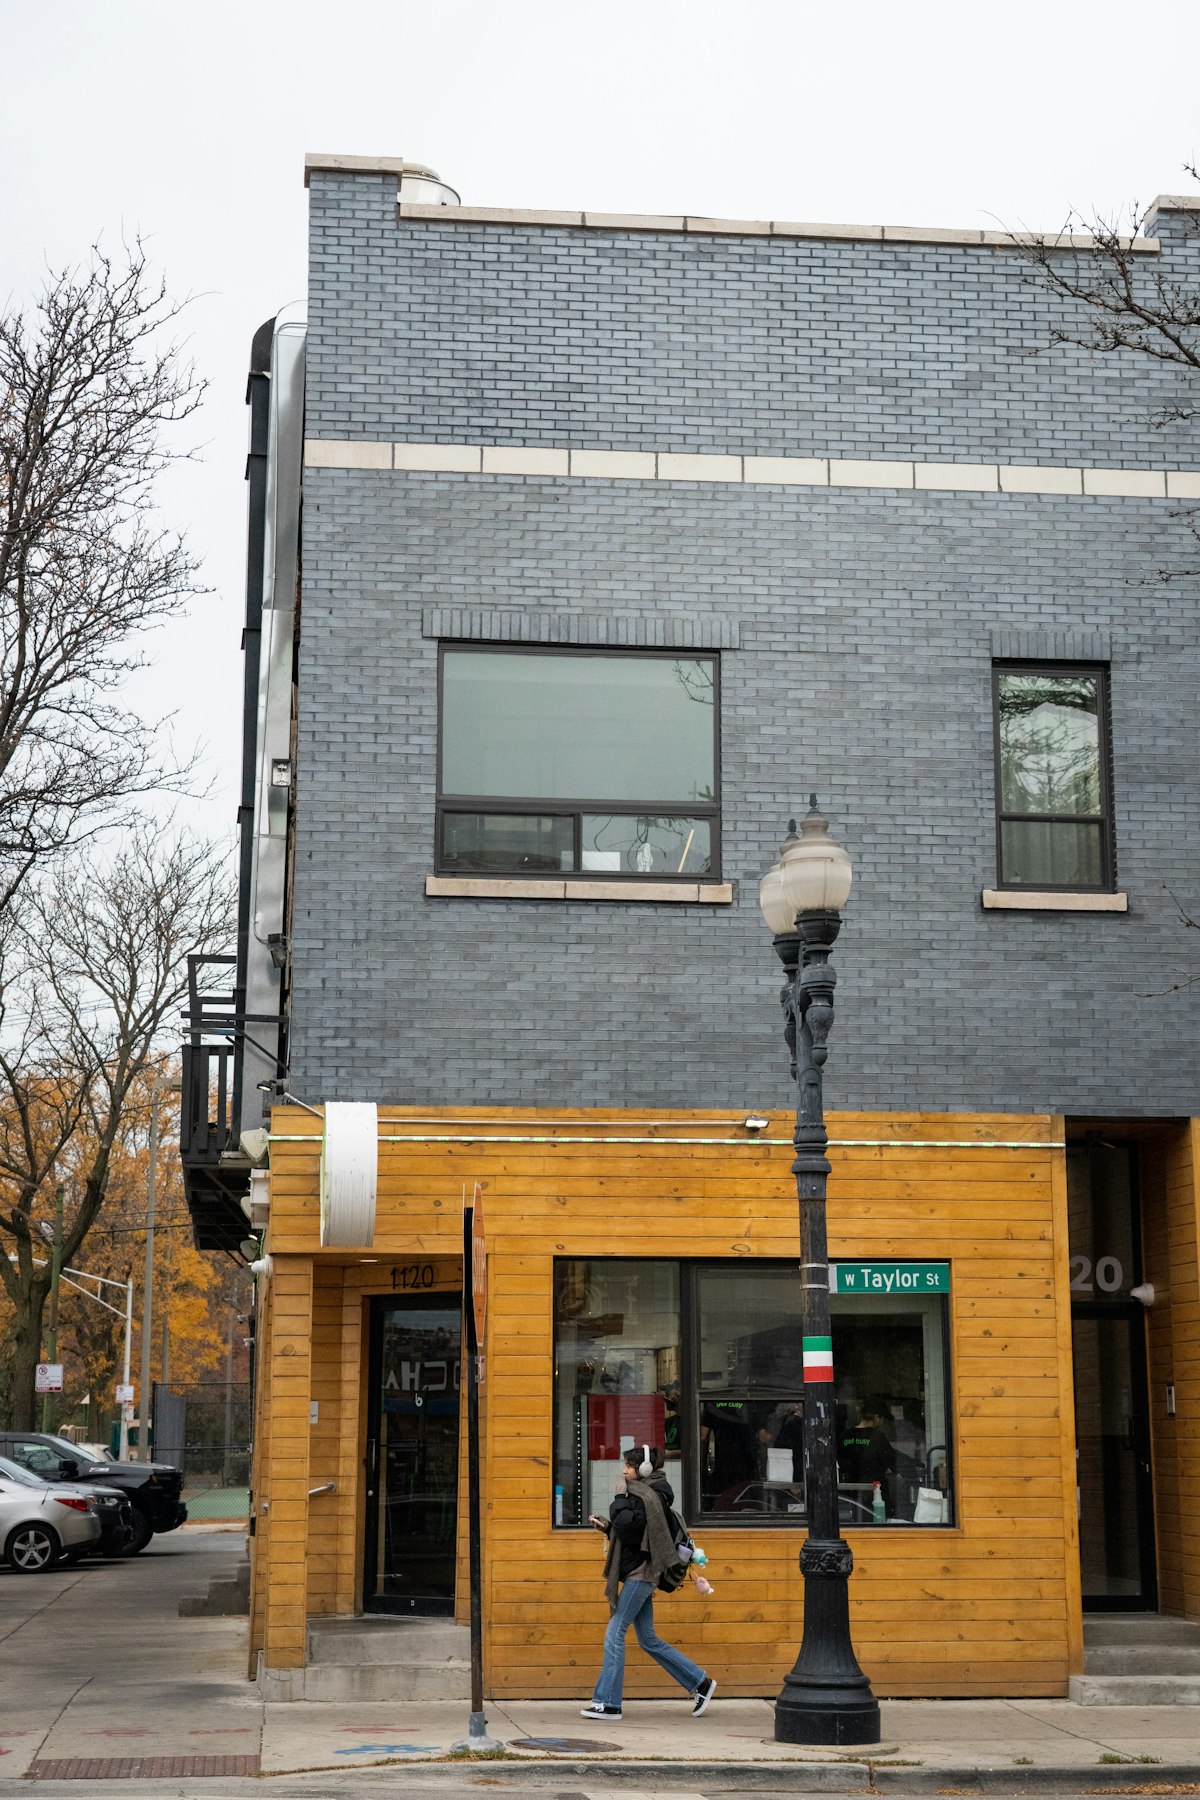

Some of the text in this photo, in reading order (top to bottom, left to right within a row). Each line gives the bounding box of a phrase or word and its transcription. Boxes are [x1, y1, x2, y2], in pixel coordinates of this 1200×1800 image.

[390, 1264, 434, 1290] 1120
[844, 1268, 940, 1292] W Taylor St
[1070, 1255, 1123, 1292] 20
[843, 1438, 870, 1446] get busy
